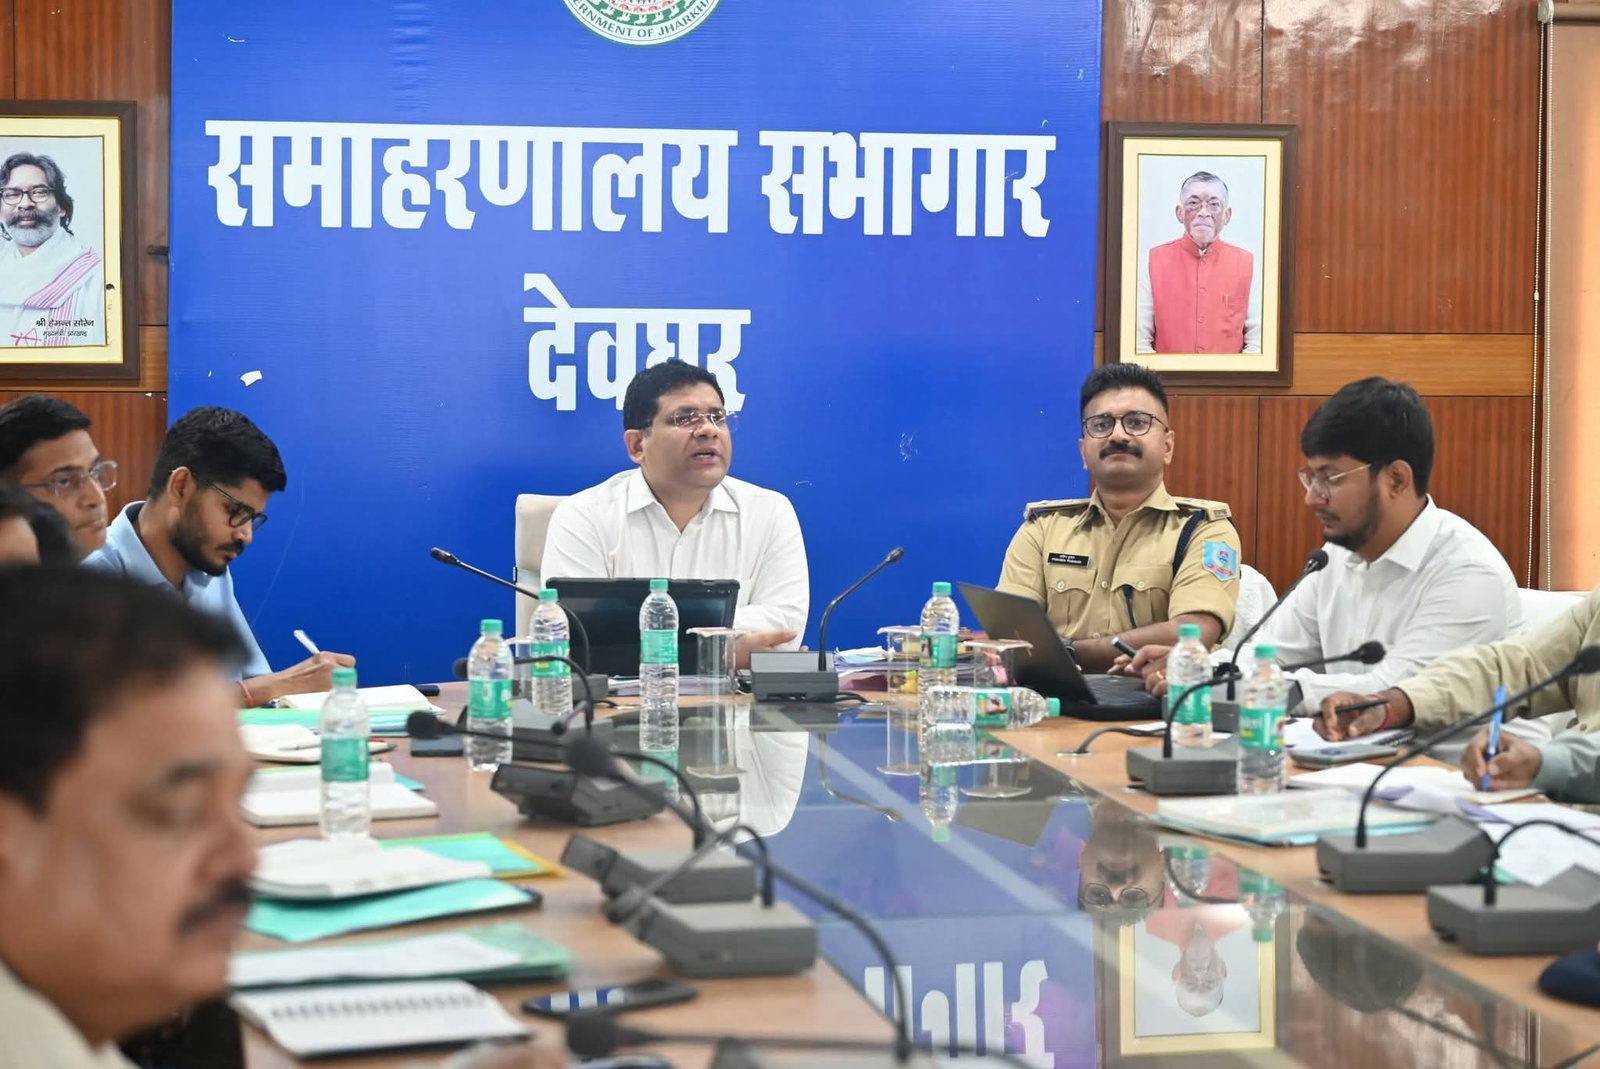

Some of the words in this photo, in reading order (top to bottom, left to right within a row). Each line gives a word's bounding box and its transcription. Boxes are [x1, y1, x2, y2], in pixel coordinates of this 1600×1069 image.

[637, 29, 654, 38] OF
[658, 0, 710, 36] JHARKH
[205, 120, 738, 234] समाहरणालय
[759, 130, 1056, 237] सभागार
[36, 317, 46, 327] श्री
[48, 318, 71, 327] हेमन्त
[73, 318, 94, 327] सोरेन
